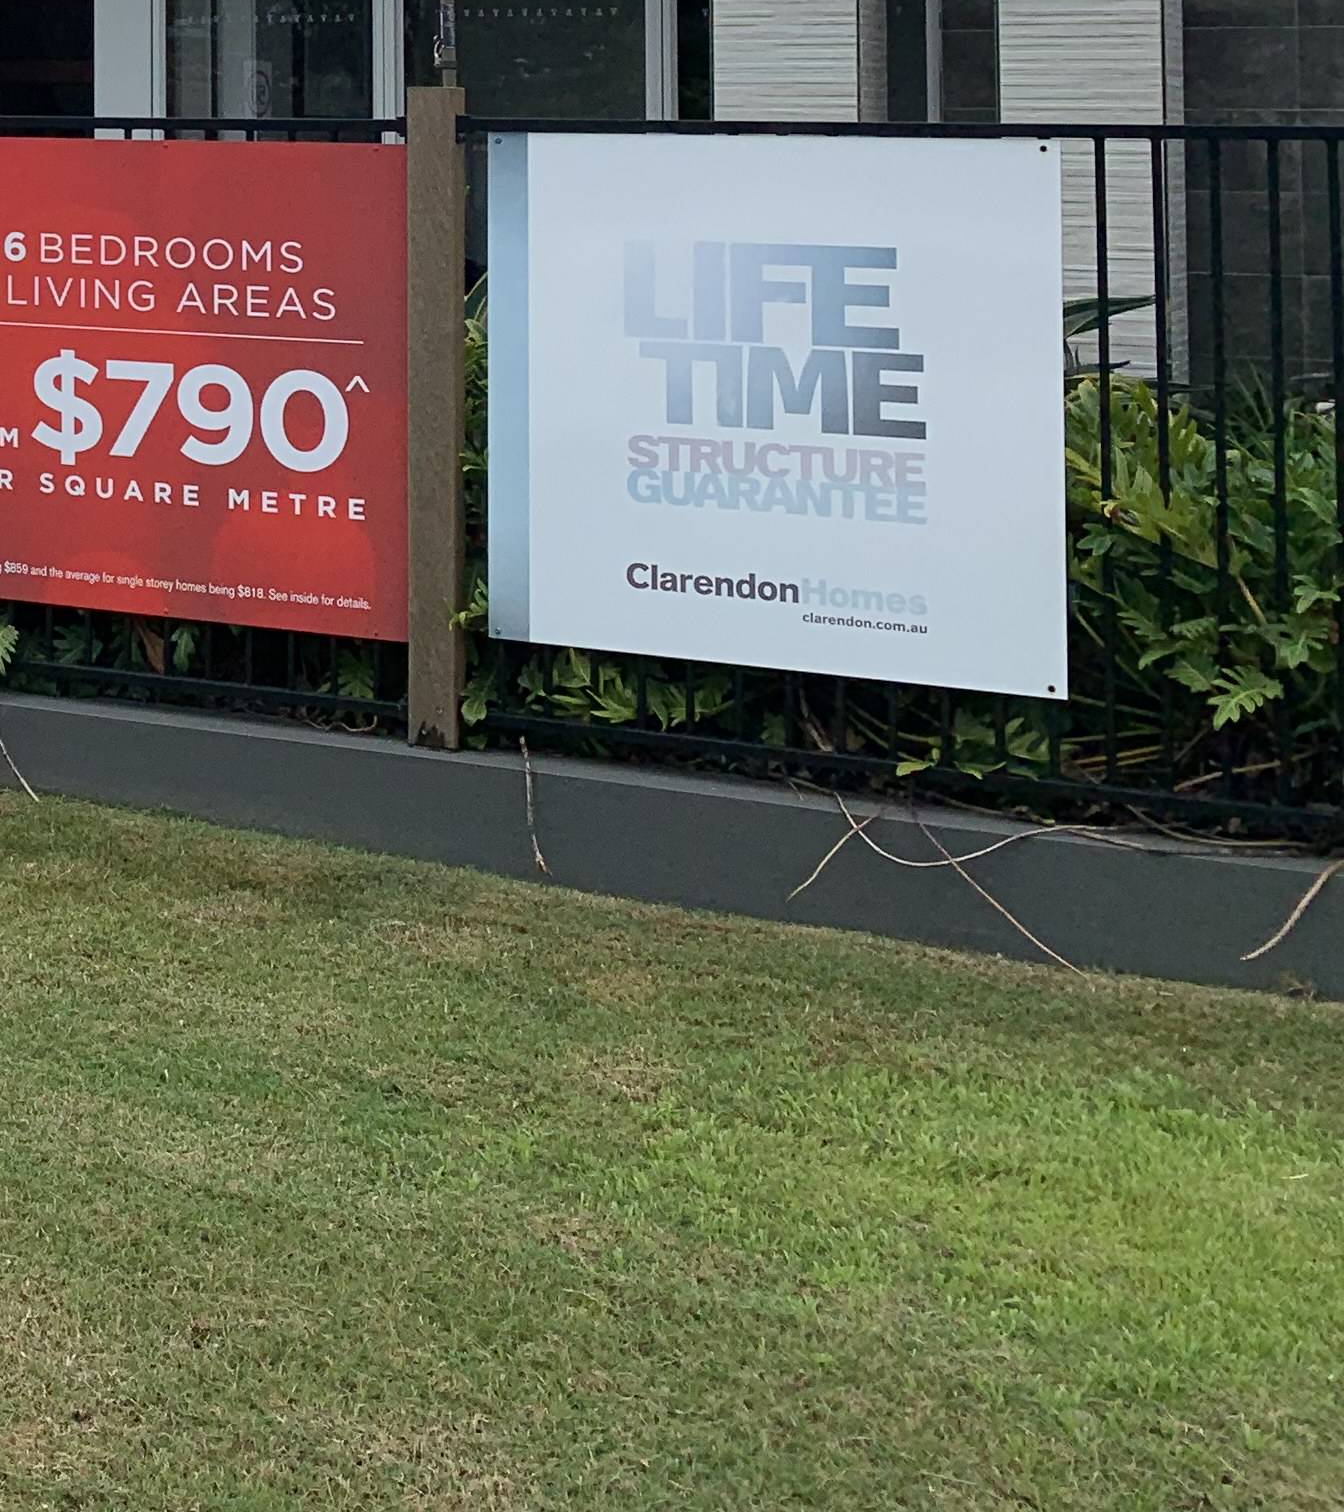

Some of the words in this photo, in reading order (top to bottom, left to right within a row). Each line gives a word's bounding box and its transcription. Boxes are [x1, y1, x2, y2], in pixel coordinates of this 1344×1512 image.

[3, 231, 28, 263] 6
[39, 232, 305, 274] BEDROOMS
[6, 274, 156, 312] LIVING
[176, 282, 337, 321] AREAS
[623, 239, 900, 350] LIFE
[638, 340, 928, 441] TIME
[627, 434, 928, 496] STRUCTURE
[39, 472, 200, 507] SQUARE
[227, 488, 367, 521] METRE
[626, 469, 928, 526] GUARANTEE
[30, 565, 48, 578] and
[48, 566, 63, 579] the
[65, 570, 101, 585] average
[102, 571, 115, 584] for
[116, 574, 144, 589] single
[145, 577, 174, 593] storey
[175, 578, 207, 594] homes
[208, 582, 236, 599] being
[268, 588, 288, 602] See
[289, 590, 320, 606] inside
[321, 593, 335, 607] for
[336, 594, 372, 610] details.
[625, 561, 929, 616] ClarendonHomes
[802, 611, 929, 635] clarendon.com.au
